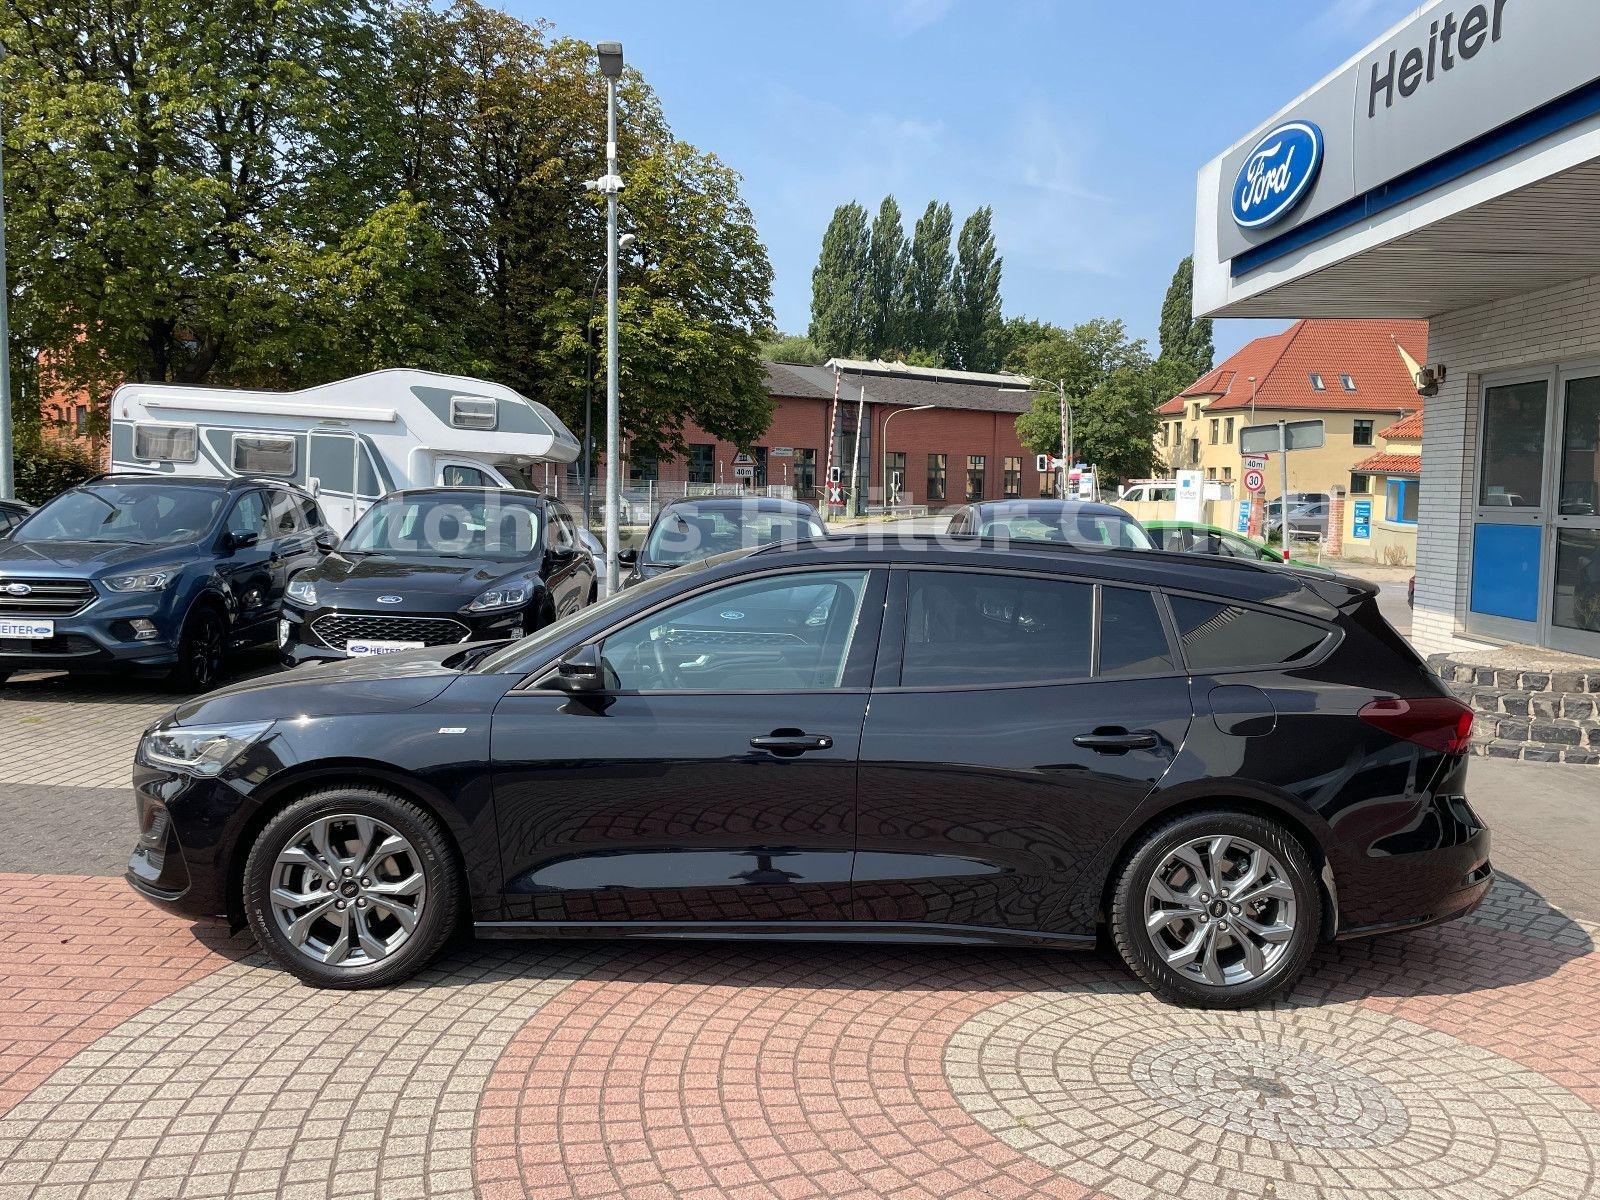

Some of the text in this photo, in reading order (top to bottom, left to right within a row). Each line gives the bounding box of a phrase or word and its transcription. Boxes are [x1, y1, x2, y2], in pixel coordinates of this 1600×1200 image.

[1368, 0, 1510, 118] Heiter
[1241, 141, 1296, 212] Ford
[1249, 475, 1259, 486] 30
[0, 625, 33, 634] EITER
